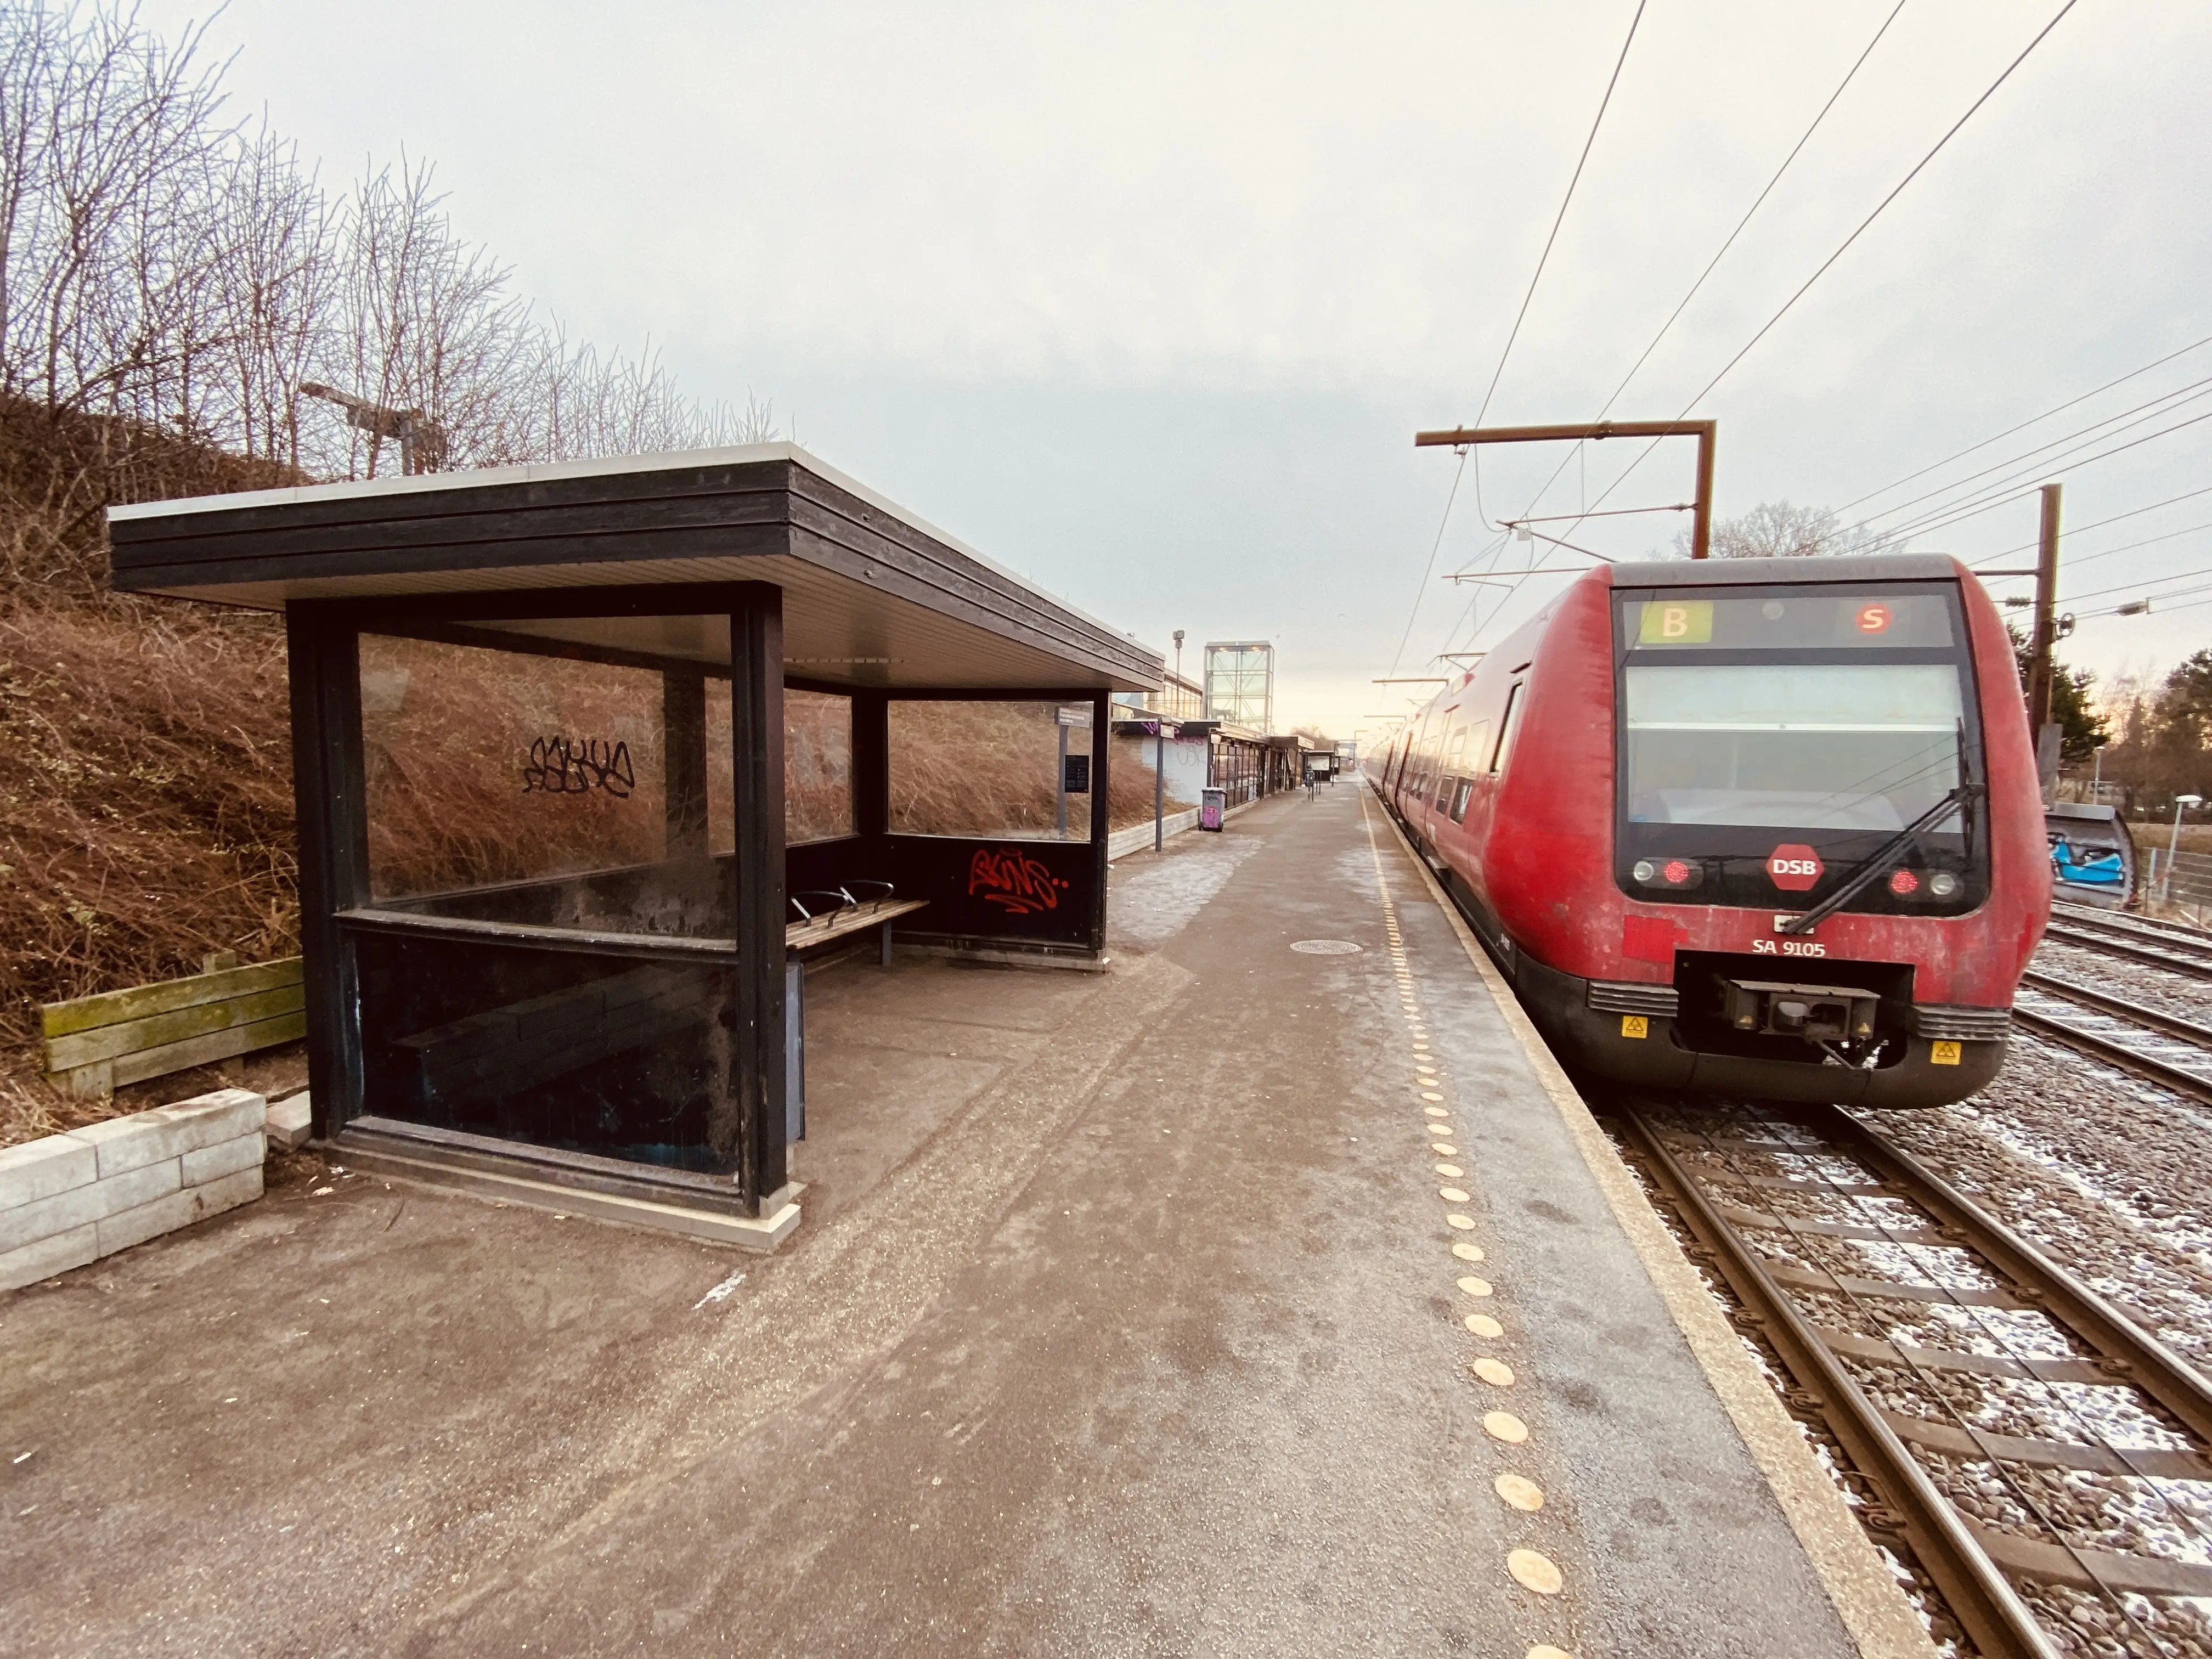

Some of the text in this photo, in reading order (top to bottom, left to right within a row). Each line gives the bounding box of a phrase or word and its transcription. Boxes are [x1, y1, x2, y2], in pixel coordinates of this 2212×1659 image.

[1663, 608, 1688, 637] B
[1862, 609, 1884, 629] S
[1773, 859, 1816, 875] DSB
[1752, 939, 1826, 957] SA 9105
